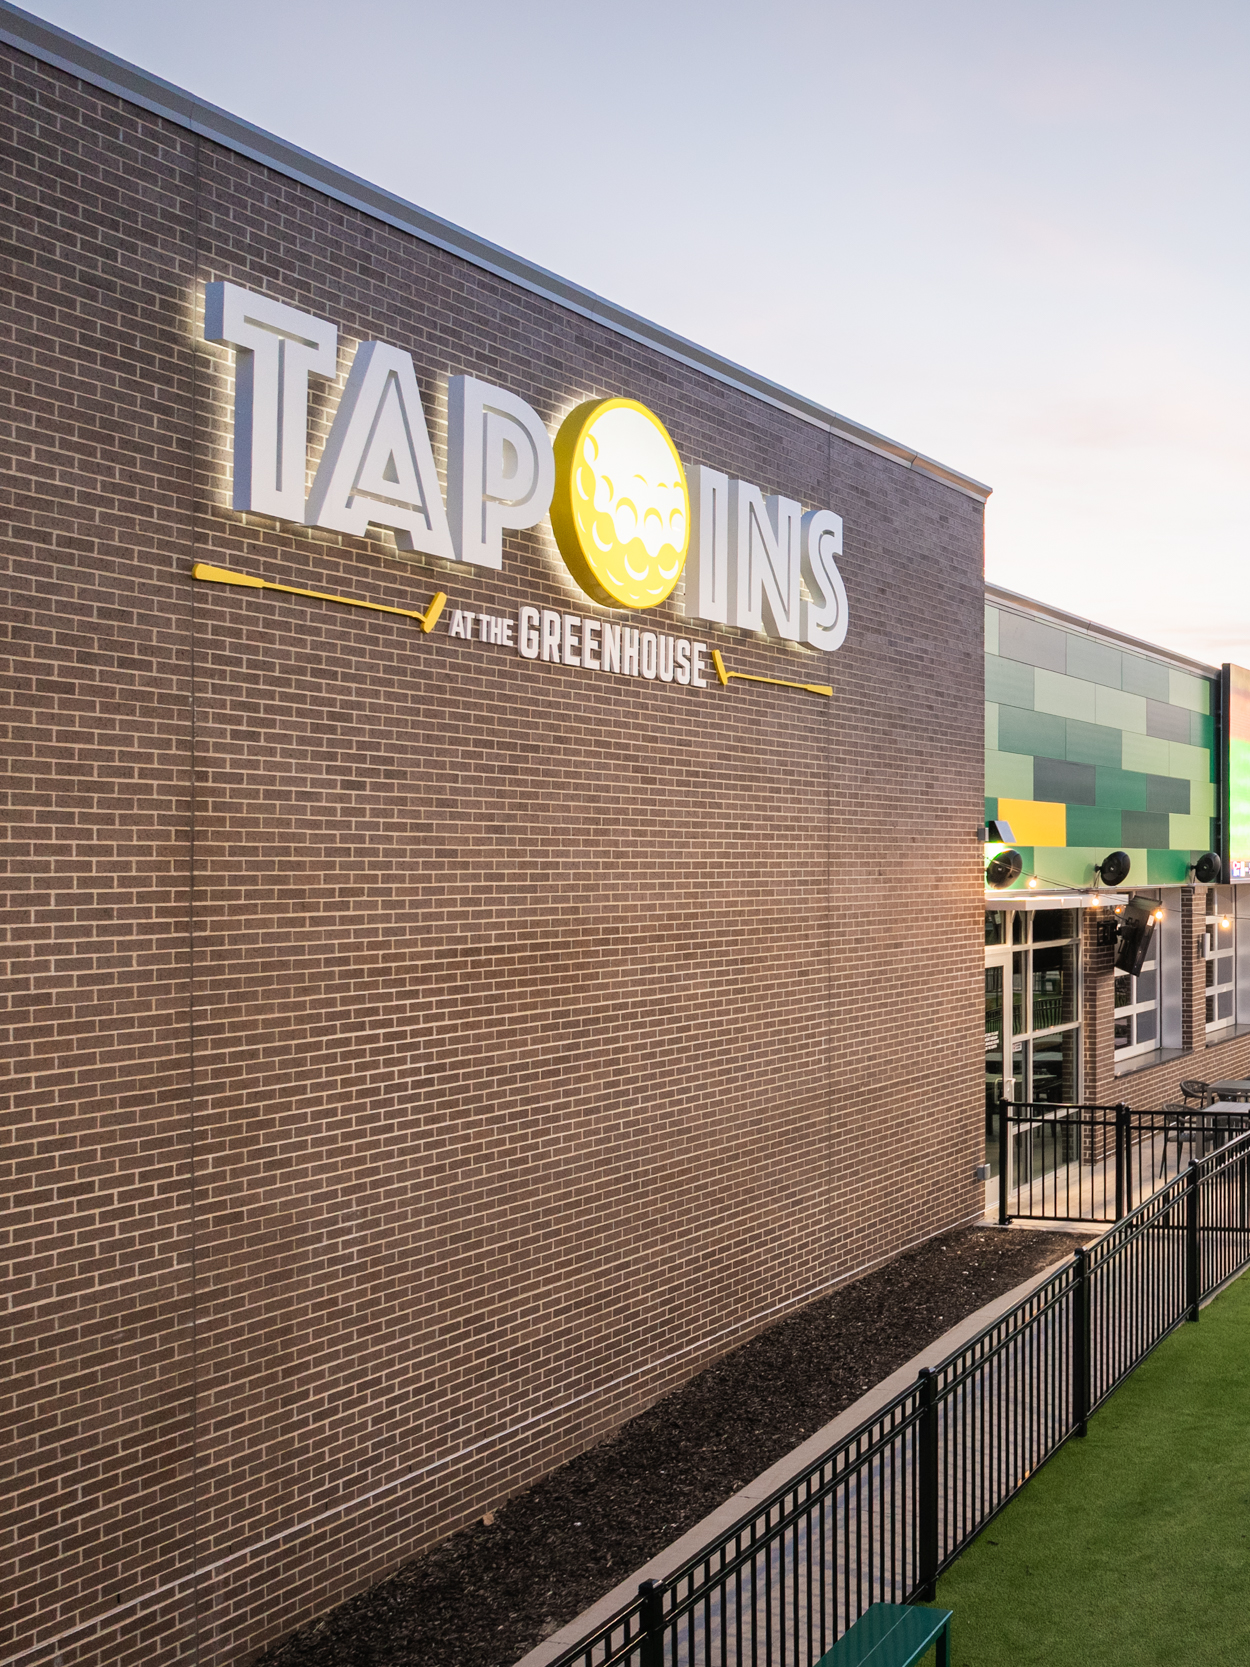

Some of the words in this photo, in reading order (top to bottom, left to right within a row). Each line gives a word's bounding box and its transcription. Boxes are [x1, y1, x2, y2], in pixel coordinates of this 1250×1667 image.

[205, 281, 556, 570] TAP
[683, 465, 849, 652] INS
[449, 609, 475, 640] AT
[478, 613, 514, 647] THE
[517, 606, 707, 688] GREENHOUSE
